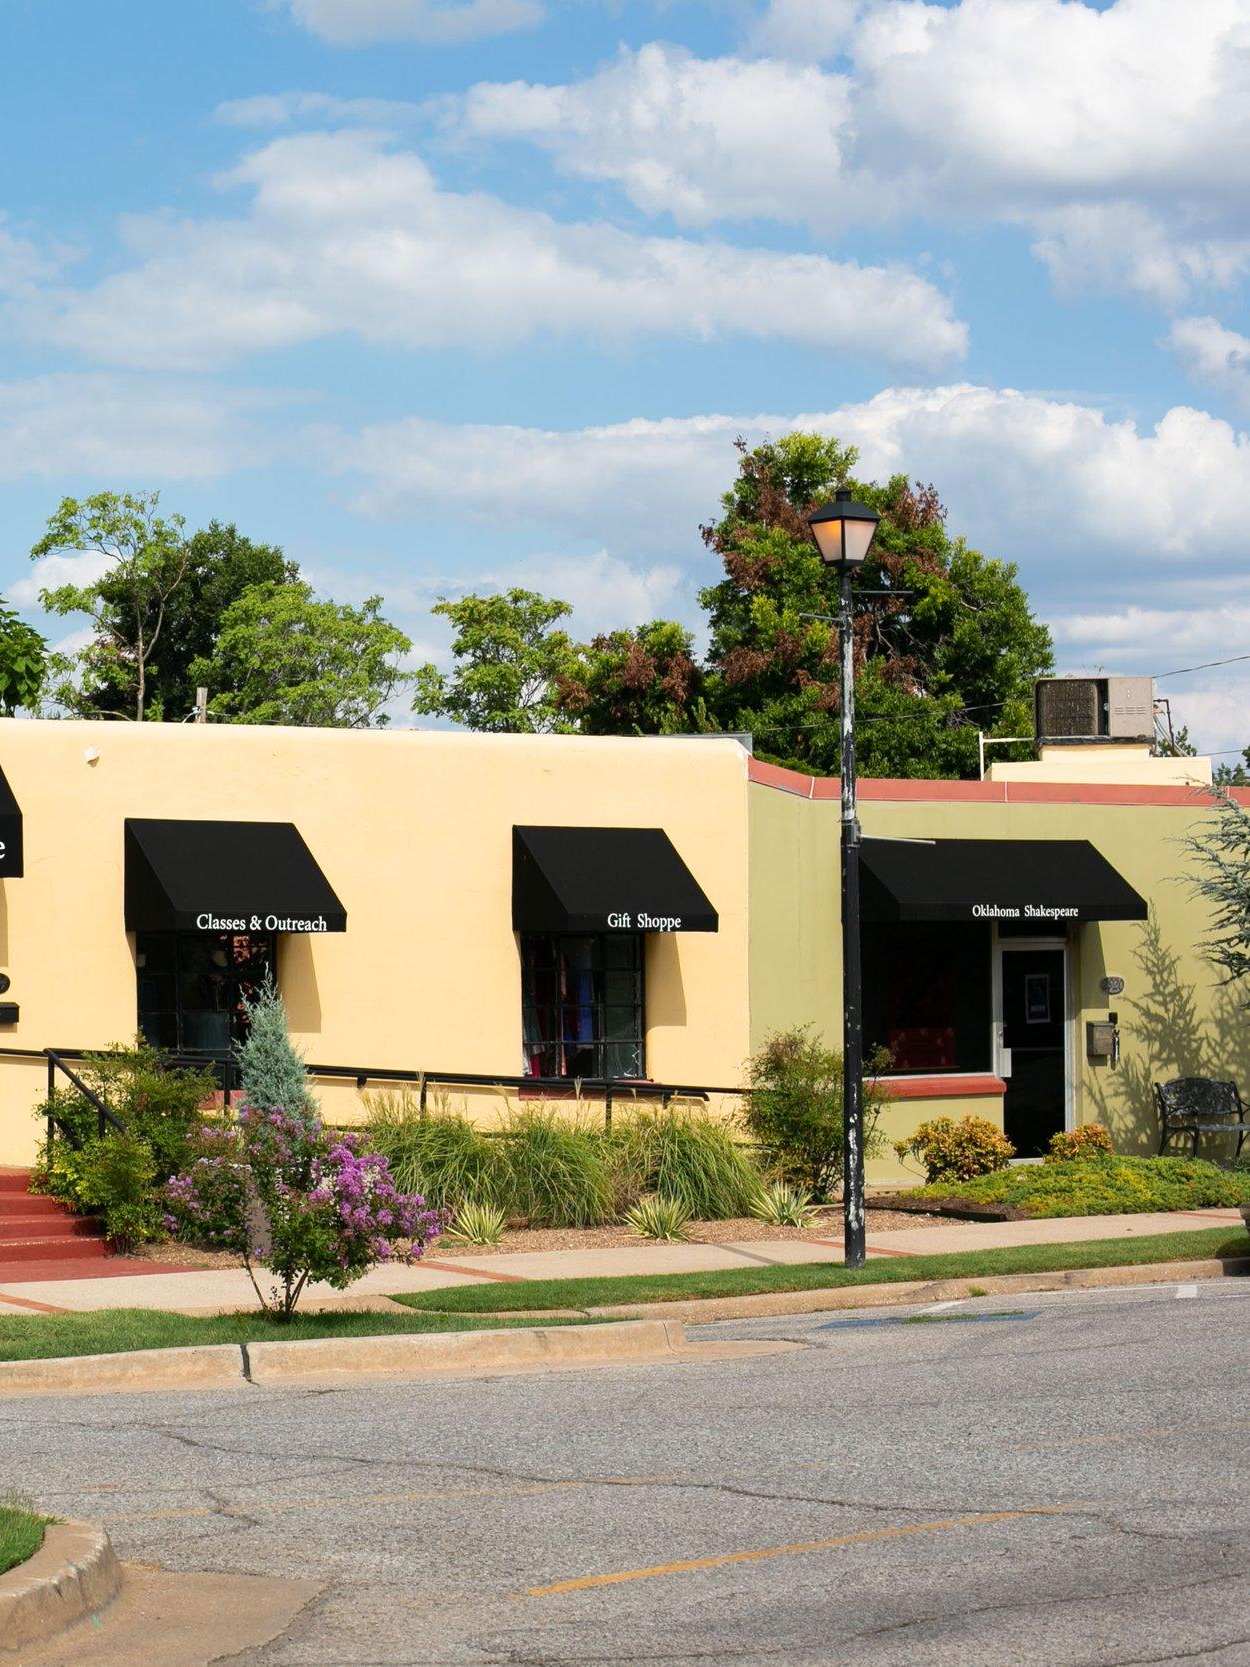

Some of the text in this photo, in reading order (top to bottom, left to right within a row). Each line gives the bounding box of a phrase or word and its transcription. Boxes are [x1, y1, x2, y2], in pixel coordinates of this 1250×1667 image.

[972, 904, 1079, 920] Oklahoma Shakespeare
[196, 914, 328, 931] Classes & Outreach
[607, 913, 682, 931] Gift Shoppe
